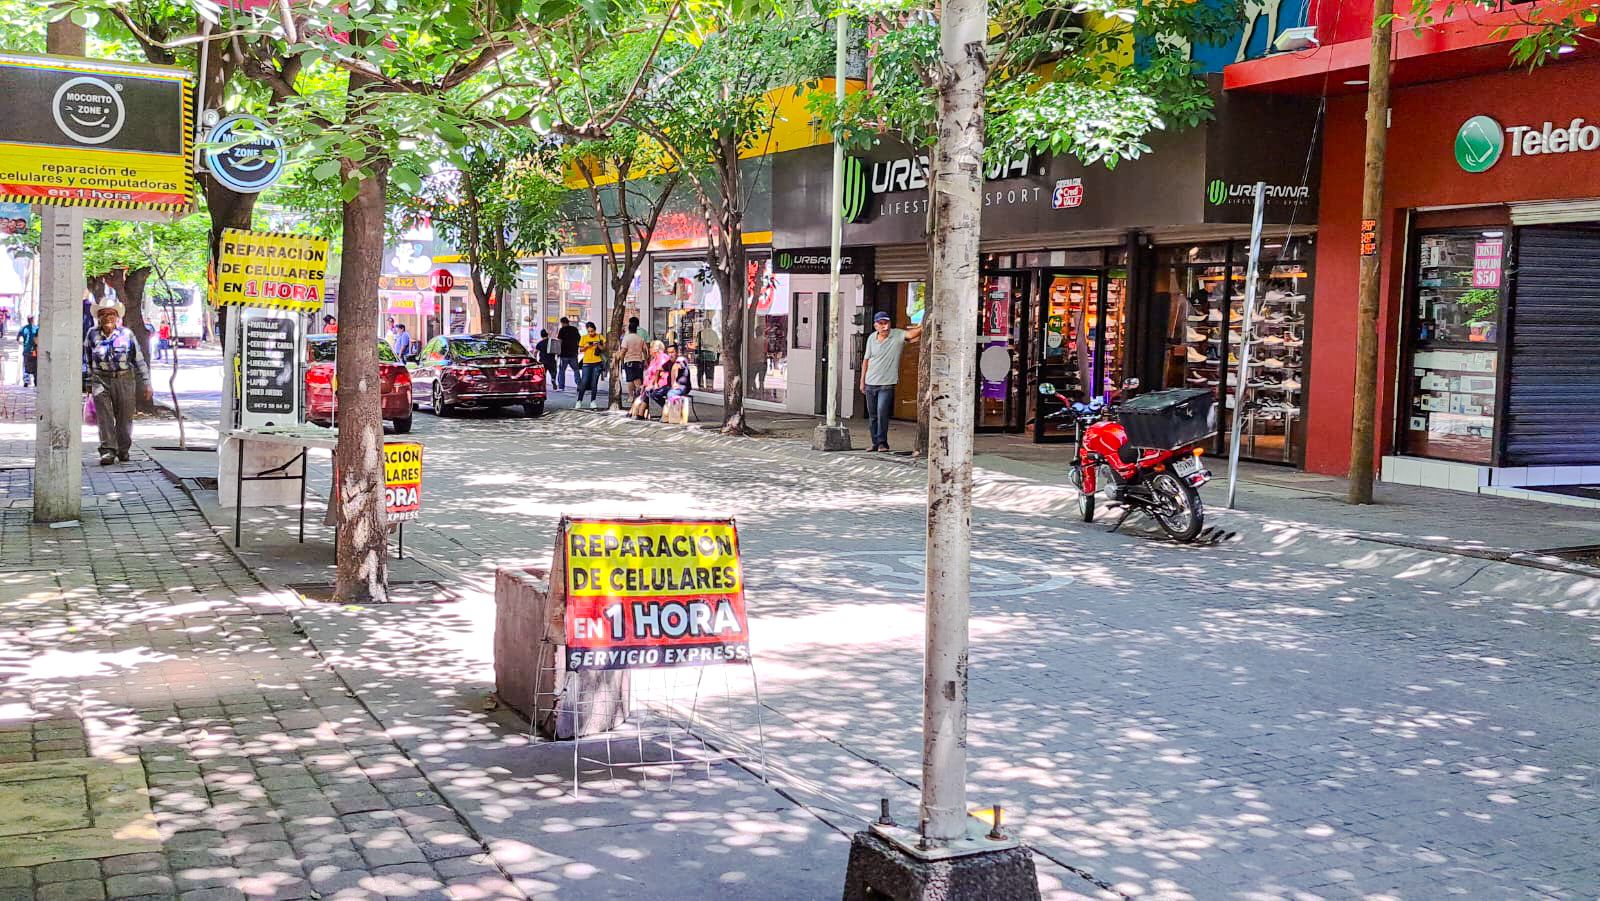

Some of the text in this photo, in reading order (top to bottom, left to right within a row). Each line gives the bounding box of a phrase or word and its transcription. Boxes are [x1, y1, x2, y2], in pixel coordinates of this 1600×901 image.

[66, 93, 112, 103] MOCORITO
[78, 105, 101, 115] ZONE
[1506, 118, 1600, 157] Telefo
[234, 148, 260, 157] ZONE
[42, 163, 137, 177] reparación de
[0, 172, 177, 190] celulares y computadoras
[48, 188, 132, 200] en 1 hora
[880, 187, 1041, 216] LIFEST SPORT
[224, 242, 324, 262] REPARACIÓN
[222, 263, 324, 280] DE CELULARES
[1477, 270, 1496, 286] $50
[431, 275, 453, 287] ALTO
[224, 280, 320, 301] EN 1 HORA
[385, 487, 418, 507] ORA
[387, 511, 420, 521] XPRESS
[571, 529, 732, 558] REPARACIÓN
[573, 566, 736, 591] DE CELULARES
[573, 600, 741, 639] EN 1 HORA
[570, 645, 749, 668] SERVICIO EXPRESS
